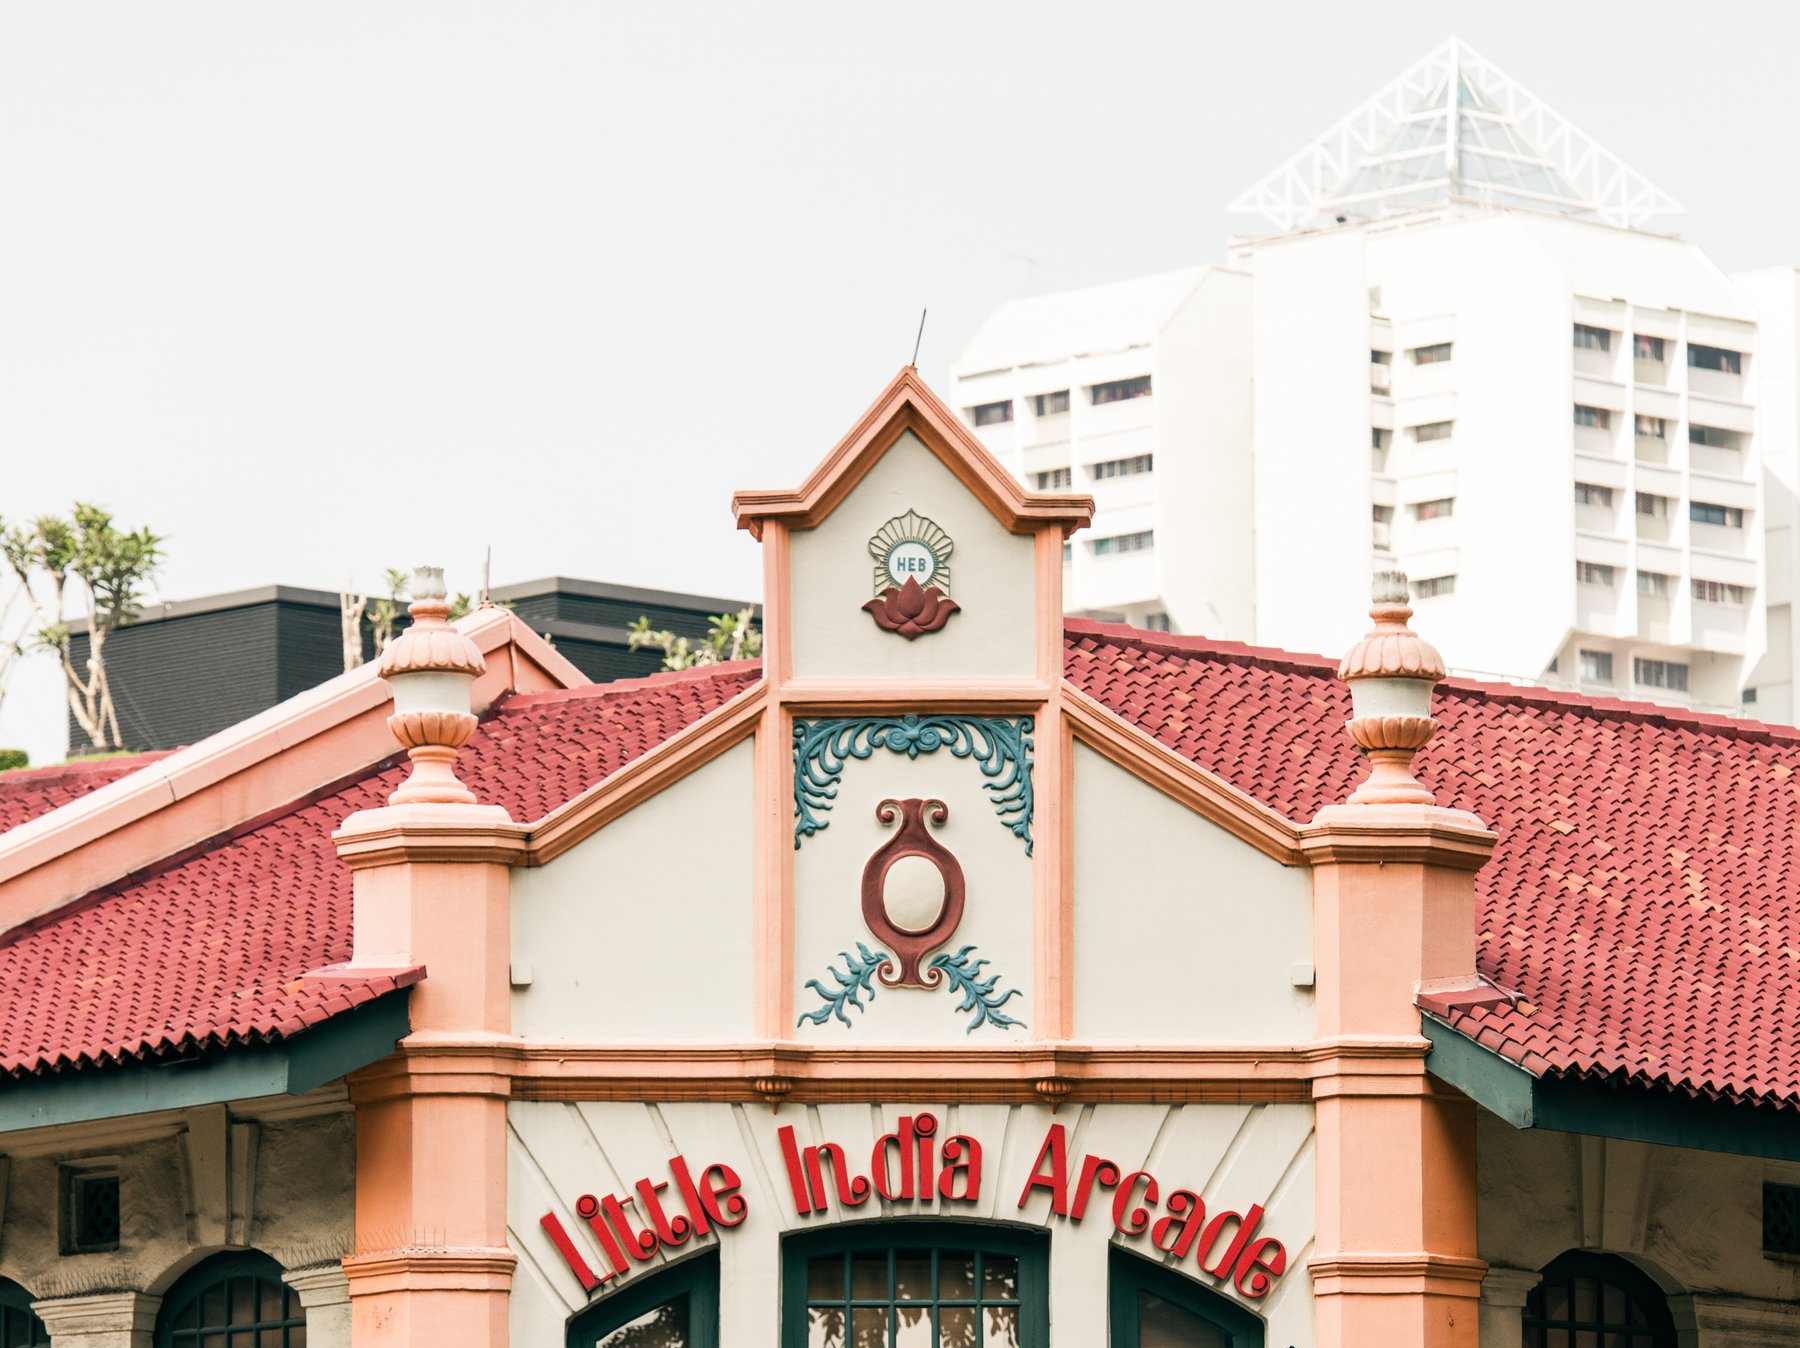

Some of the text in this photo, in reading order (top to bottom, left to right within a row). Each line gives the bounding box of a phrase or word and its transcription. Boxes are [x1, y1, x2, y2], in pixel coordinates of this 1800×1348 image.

[897, 557, 926, 572] HEB
[540, 1112, 1287, 1298] Little India Arcade
